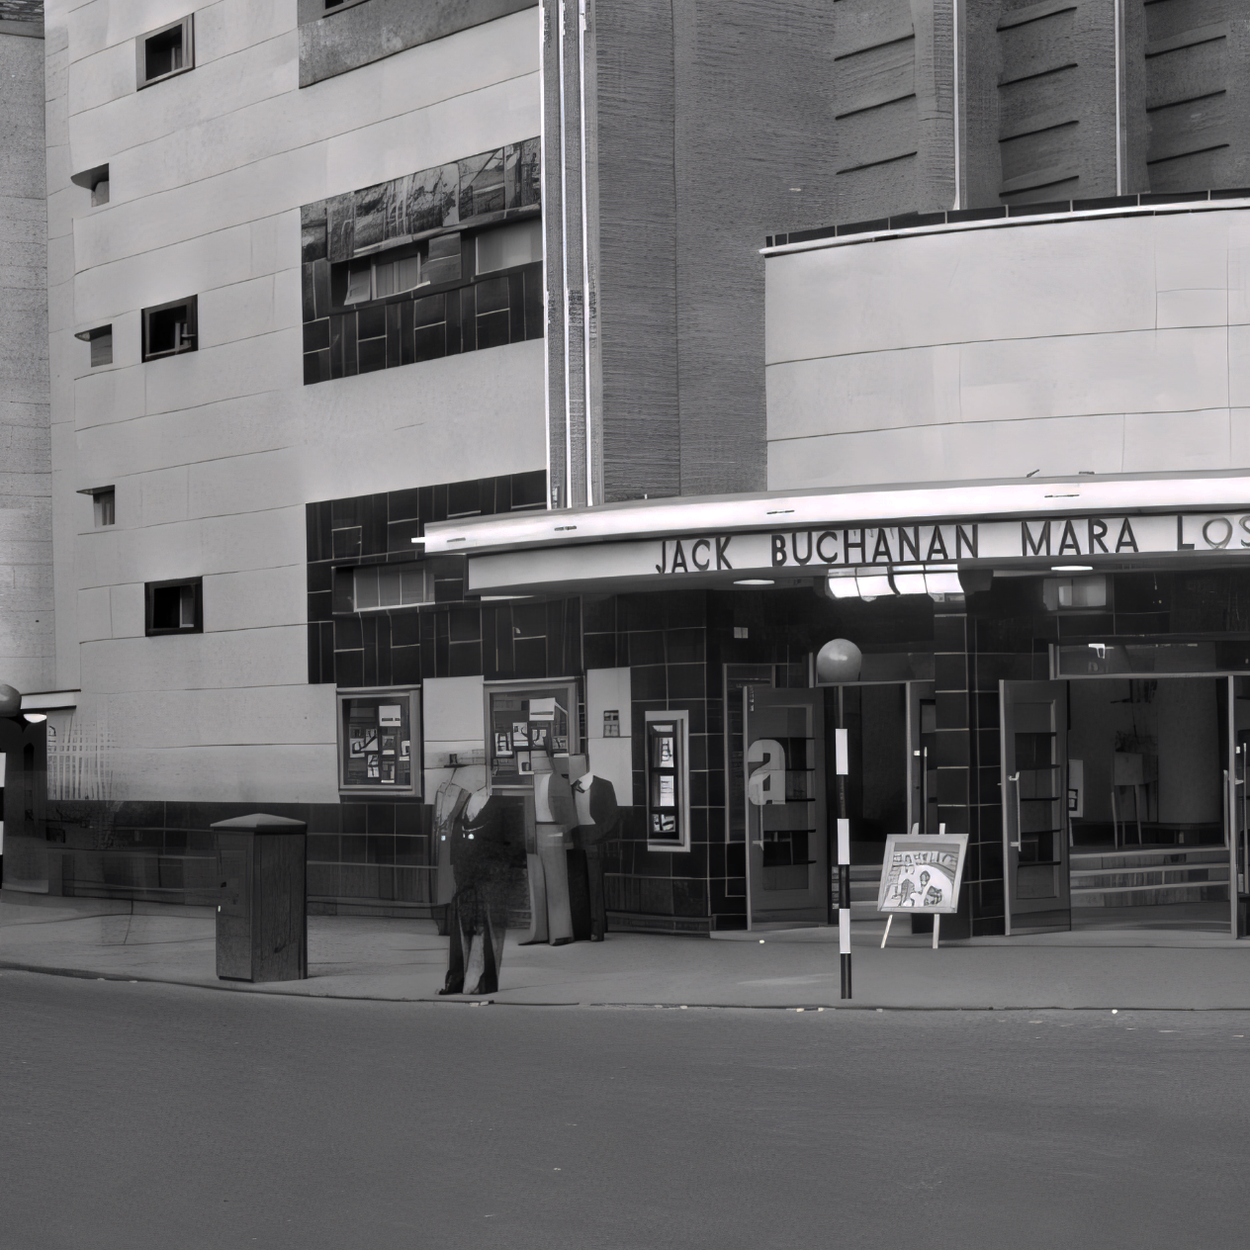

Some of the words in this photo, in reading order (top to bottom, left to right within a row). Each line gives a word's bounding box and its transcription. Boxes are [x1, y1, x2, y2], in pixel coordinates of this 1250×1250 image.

[655, 535, 734, 574] JACK
[771, 523, 979, 568] BUCHANAN
[1020, 517, 1139, 557] MARA
